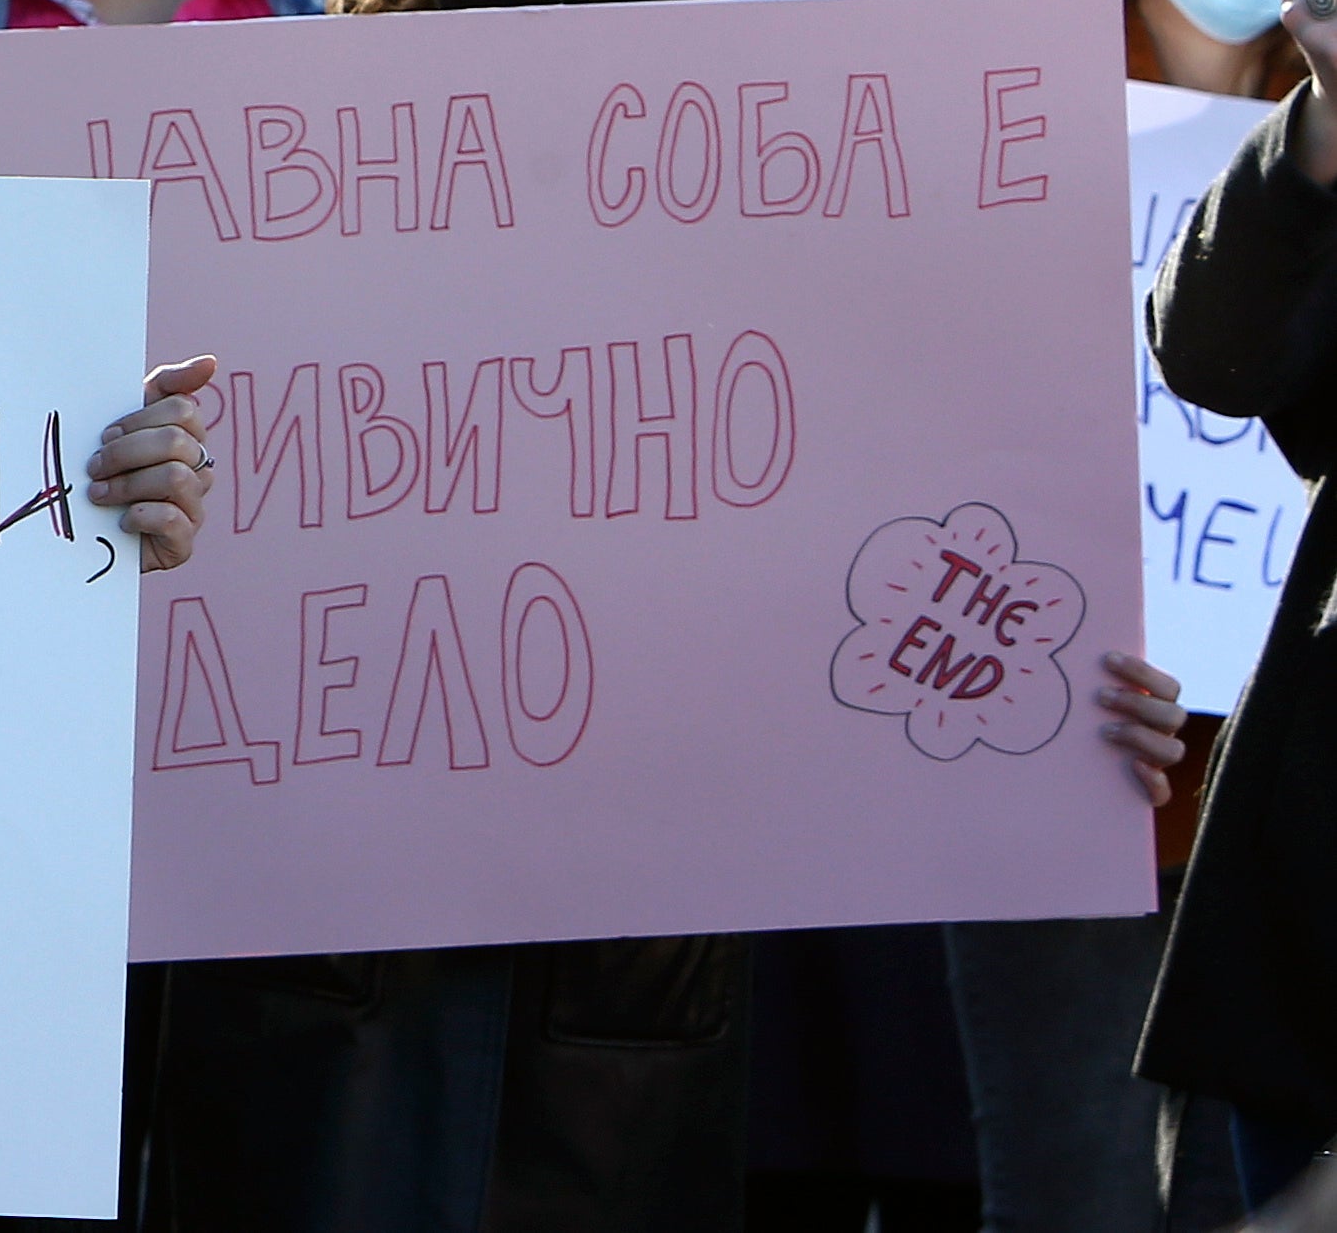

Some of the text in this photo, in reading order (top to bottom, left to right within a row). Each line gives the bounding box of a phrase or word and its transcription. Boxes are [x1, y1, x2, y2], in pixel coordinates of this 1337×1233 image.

[586, 72, 911, 228] СОБА
[979, 66, 1049, 209] Е
[888, 615, 1004, 700] END
[930, 549, 1039, 646] THE
[152, 561, 595, 787] ДЕЛО
